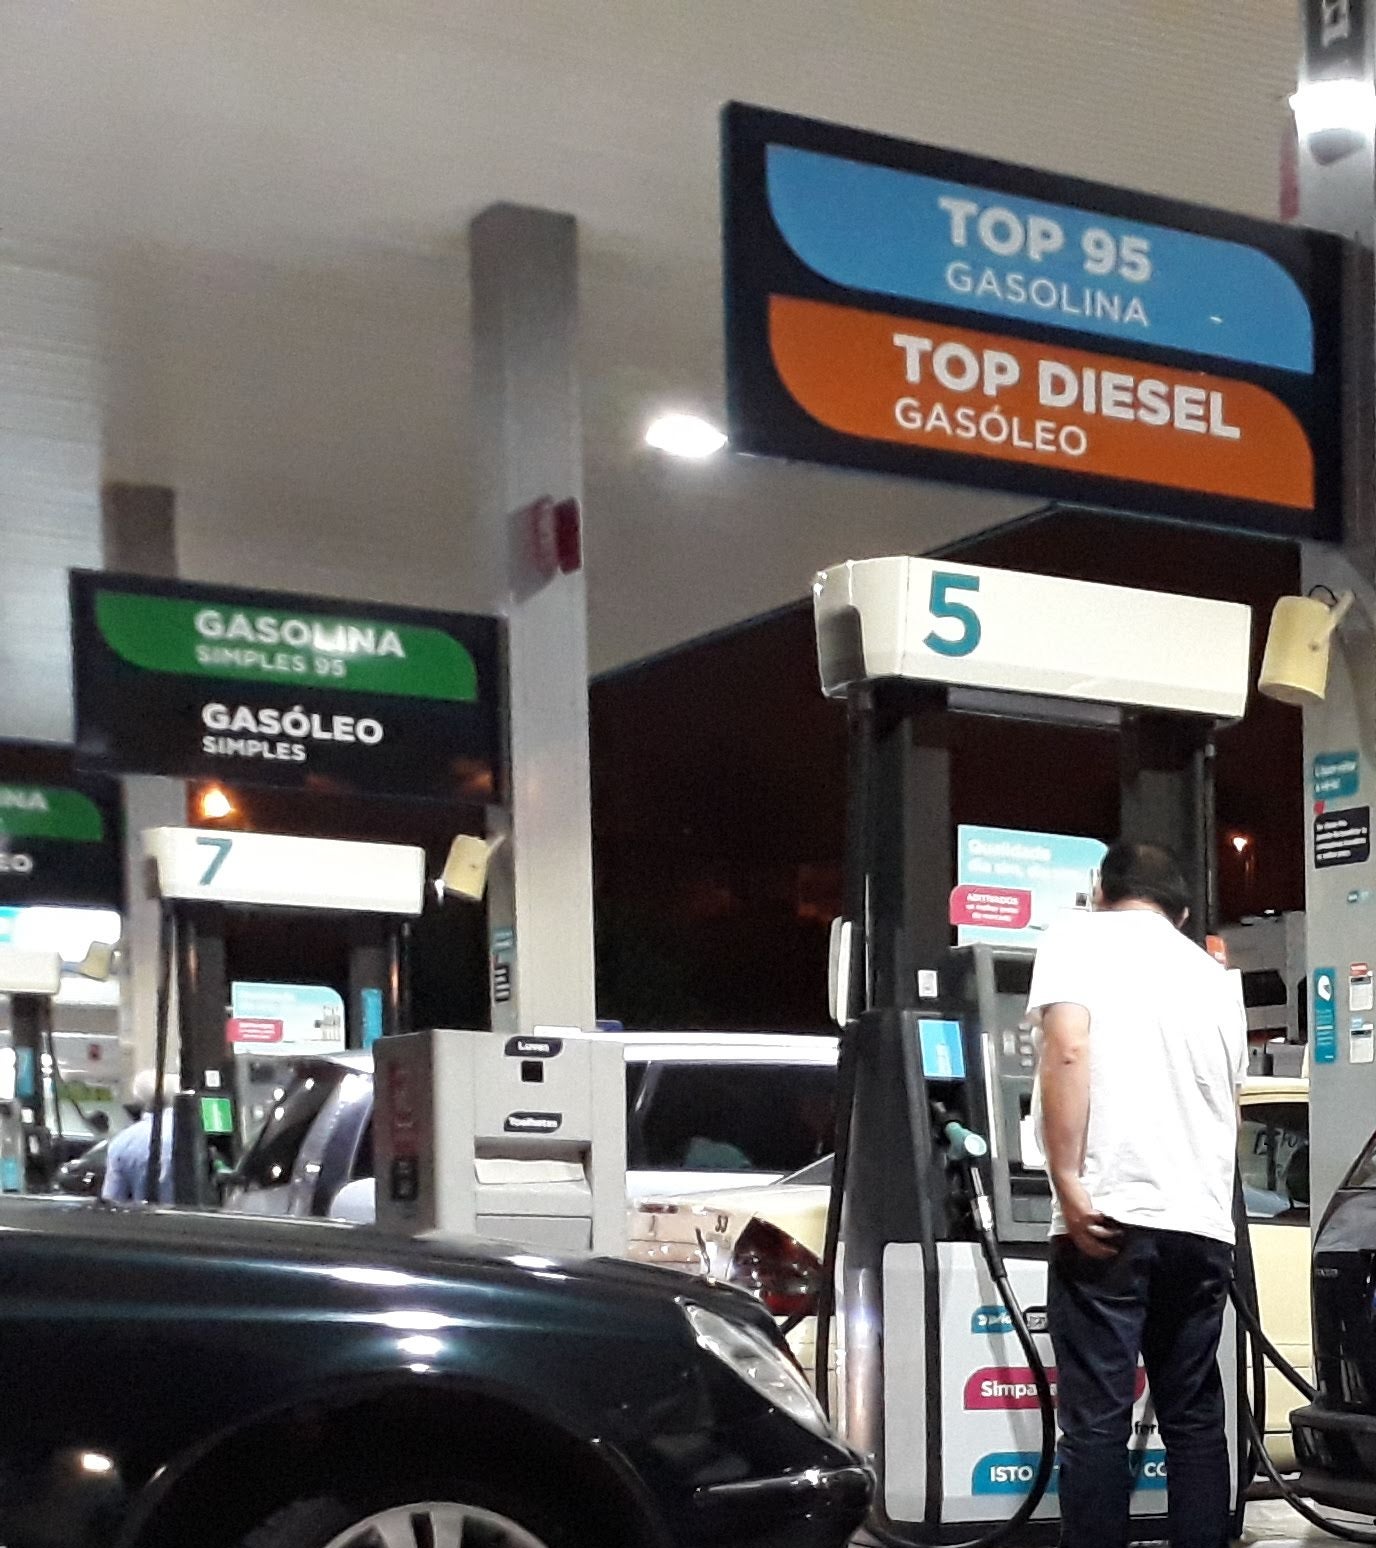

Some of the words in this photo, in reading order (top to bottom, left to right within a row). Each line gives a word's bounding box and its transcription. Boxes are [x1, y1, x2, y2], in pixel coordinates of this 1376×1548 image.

[939, 196, 1064, 263] TOP
[1081, 228, 1154, 283] 95
[945, 262, 1149, 327] GASOLINA
[893, 332, 1020, 396] TOP
[1038, 359, 1241, 439] DIESEL
[894, 398, 1088, 457] GASÓLEO
[194, 610, 406, 658] GASOLINA
[922, 570, 982, 657] 5
[196, 645, 306, 673] SIMPLES
[314, 656, 347, 678] 95
[202, 703, 384, 746] GASÓLEO
[202, 735, 307, 762] SIMPLES
[195, 837, 234, 886] 7
[990, 1465, 1033, 1483] ISTO
